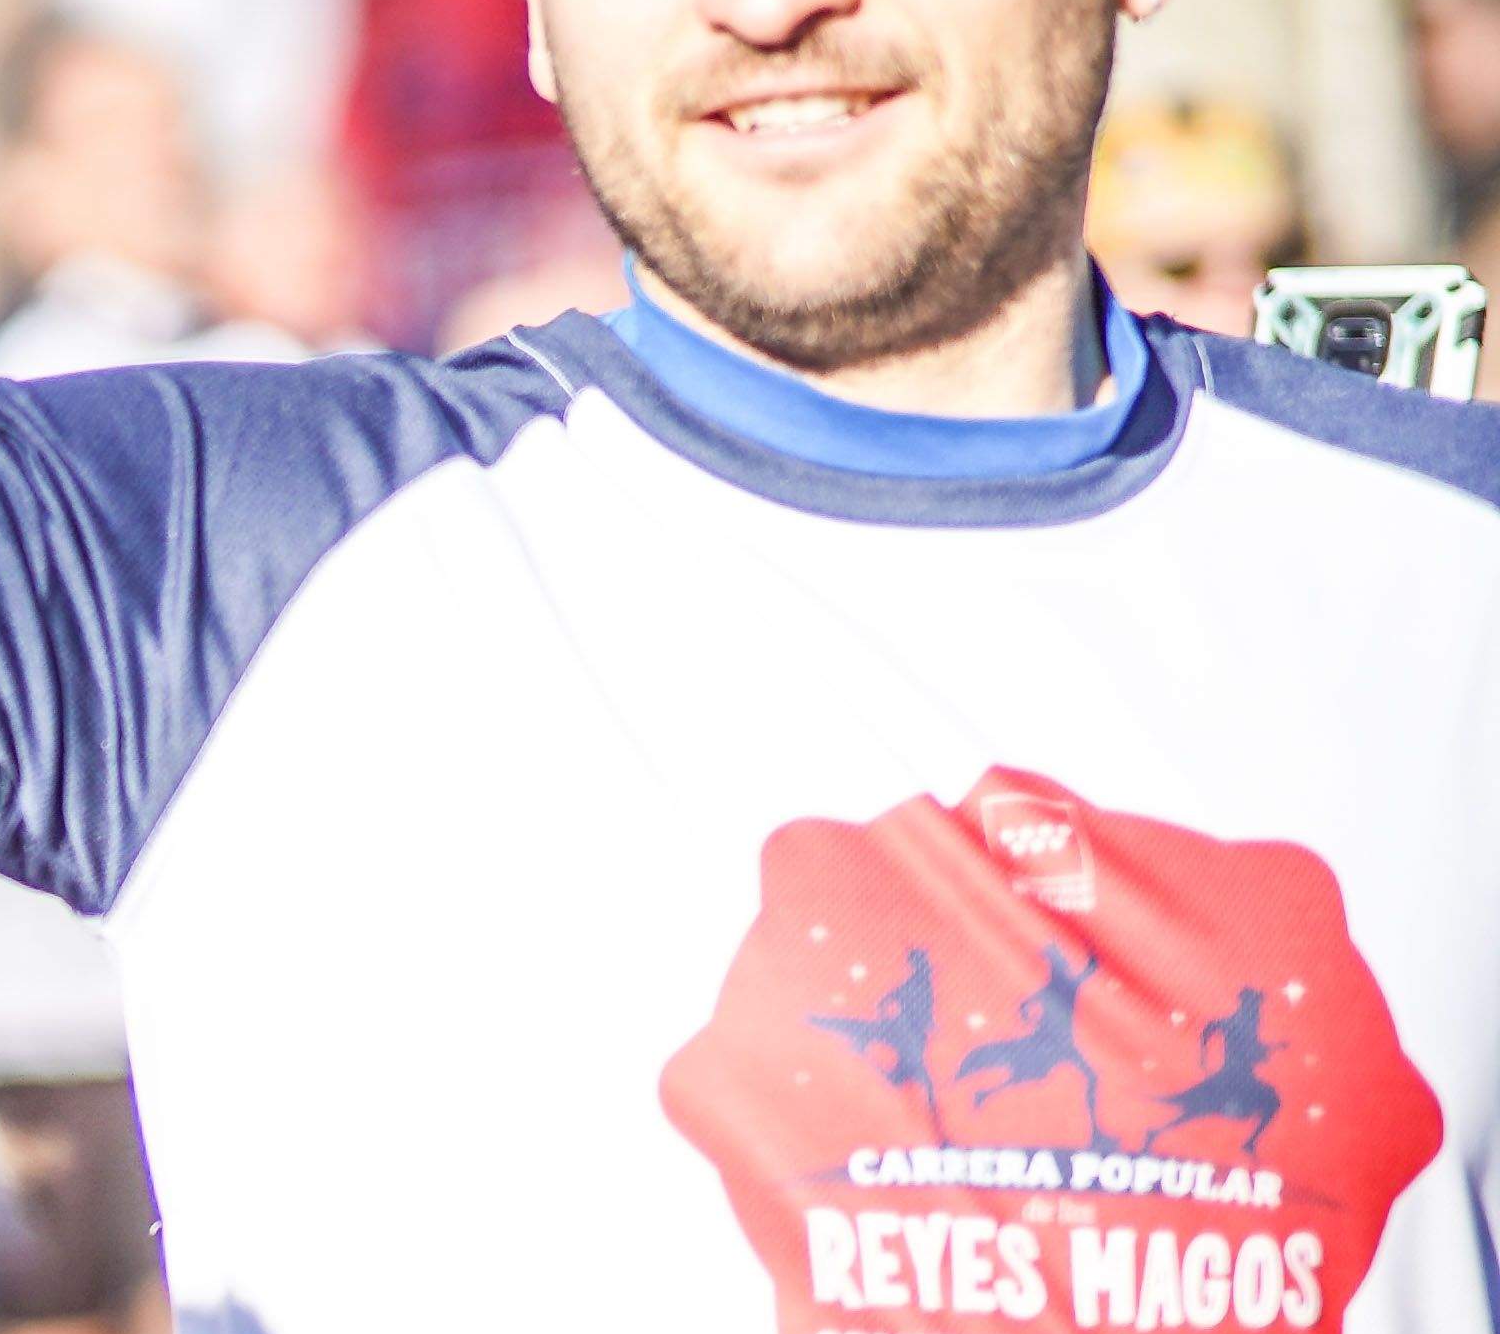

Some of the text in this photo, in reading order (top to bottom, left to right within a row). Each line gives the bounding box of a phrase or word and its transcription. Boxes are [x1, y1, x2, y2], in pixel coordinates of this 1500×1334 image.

[847, 1148, 1283, 1209] CARRERA POPULAR
[806, 1208, 1324, 1332] REYES MAGOS
